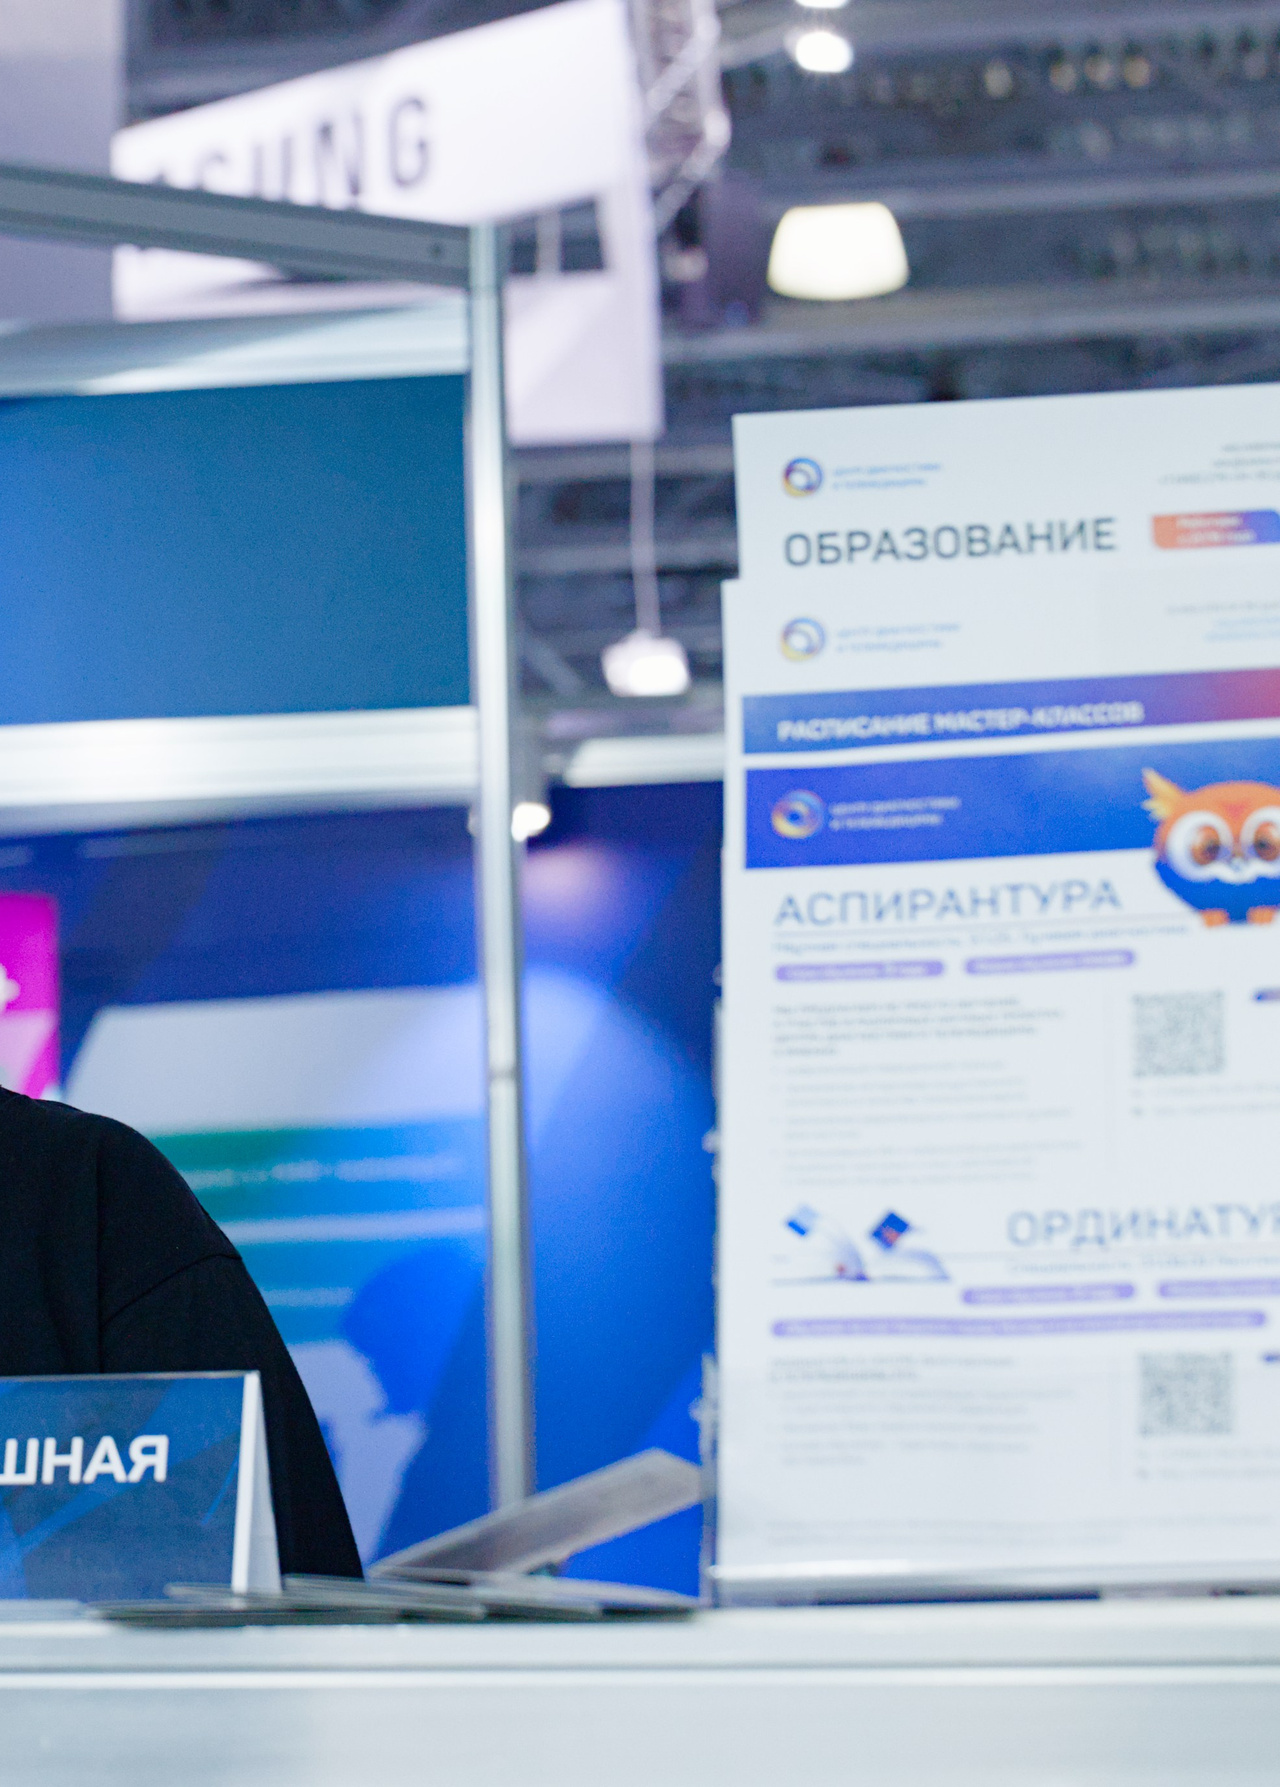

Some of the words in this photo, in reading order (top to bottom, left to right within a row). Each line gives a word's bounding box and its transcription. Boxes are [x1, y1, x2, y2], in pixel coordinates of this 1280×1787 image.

[784, 516, 1117, 567] ОБРАЗОВАНИЕ
[776, 712, 931, 742] РАСПИСАНИЕ
[933, 701, 1145, 732] МАСТЕР-КЛАССОВ
[773, 878, 1124, 928] АСПИРАНТУРА
[1006, 1203, 1280, 1251] ОРДИНАТУ
